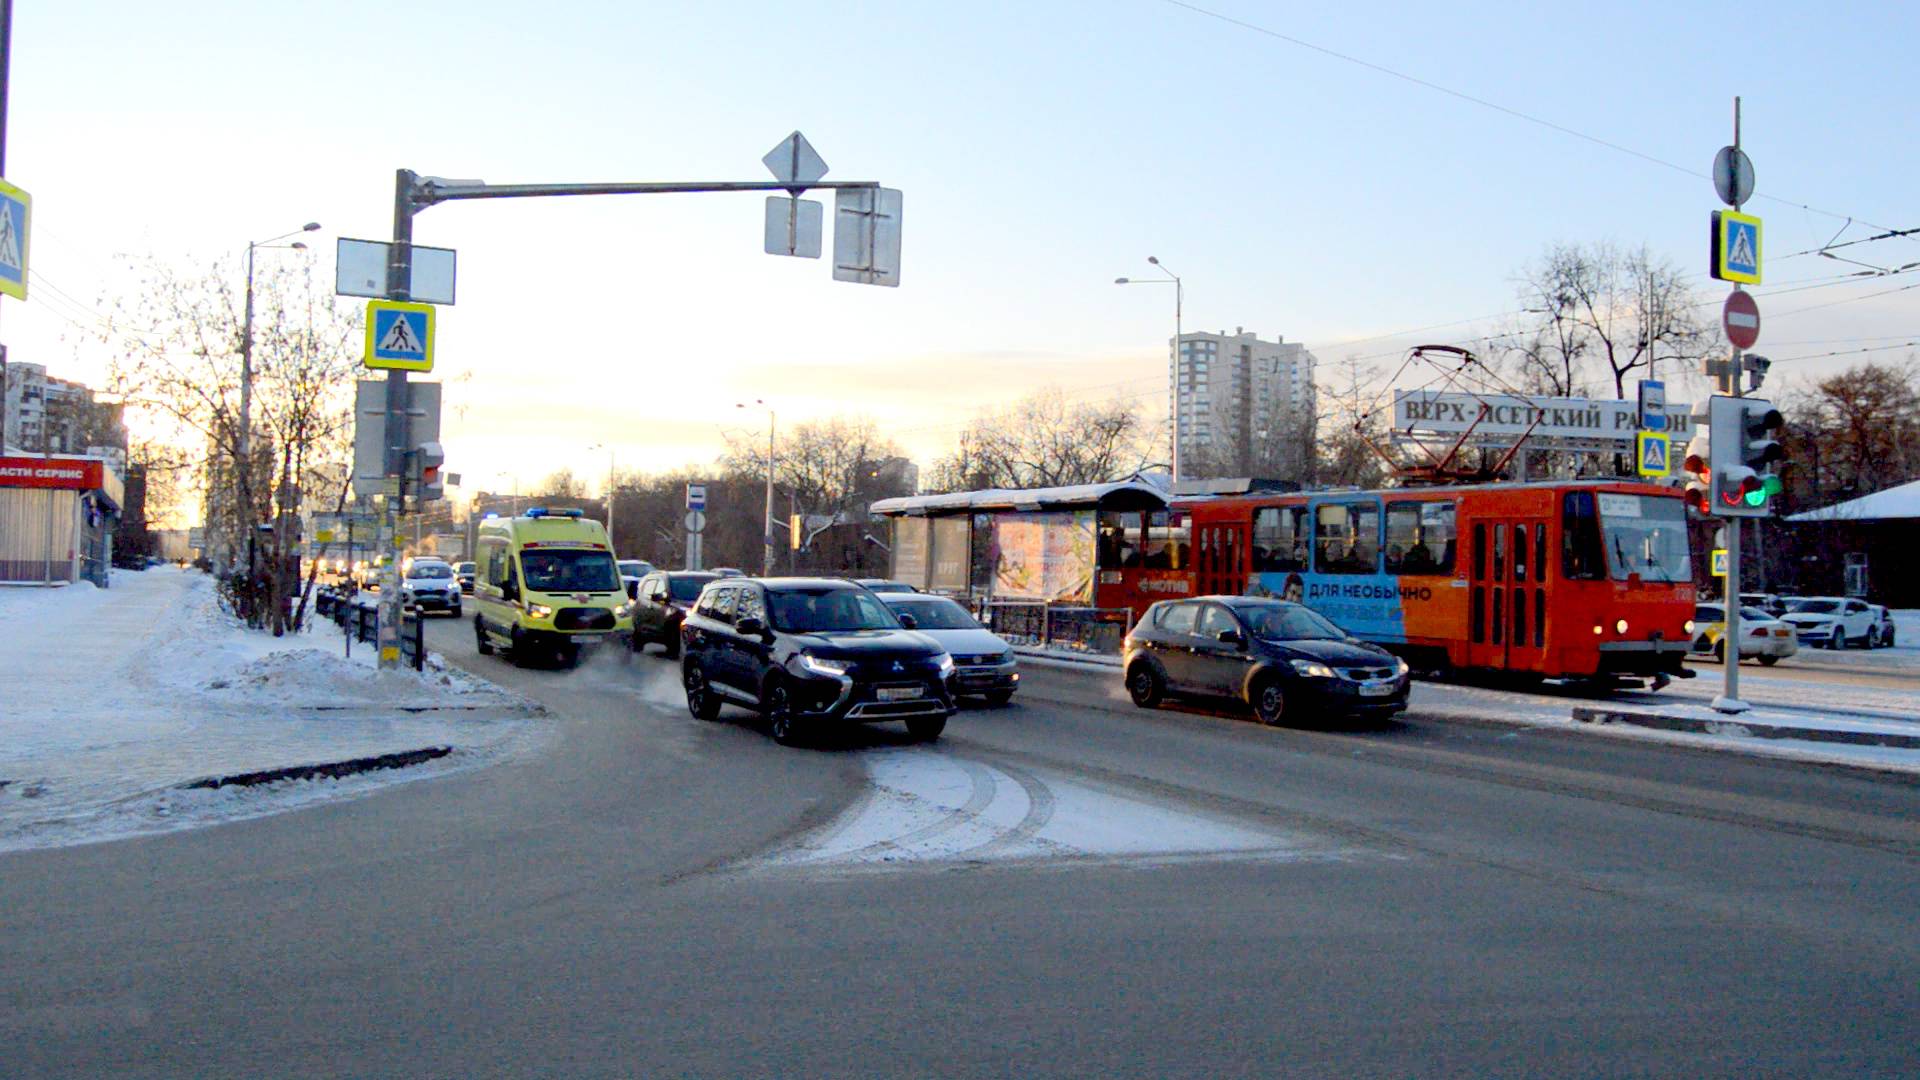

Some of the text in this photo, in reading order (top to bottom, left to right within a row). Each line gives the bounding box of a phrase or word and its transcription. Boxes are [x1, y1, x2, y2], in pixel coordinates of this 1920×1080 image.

[1406, 400, 1687, 433] ВЕРХ-ИСЕТСКИЙ РАОН
[35, 468, 84, 479] СЕРВИС
[1309, 583, 1432, 602] ДЛЯ НЕОБЫЧНО
